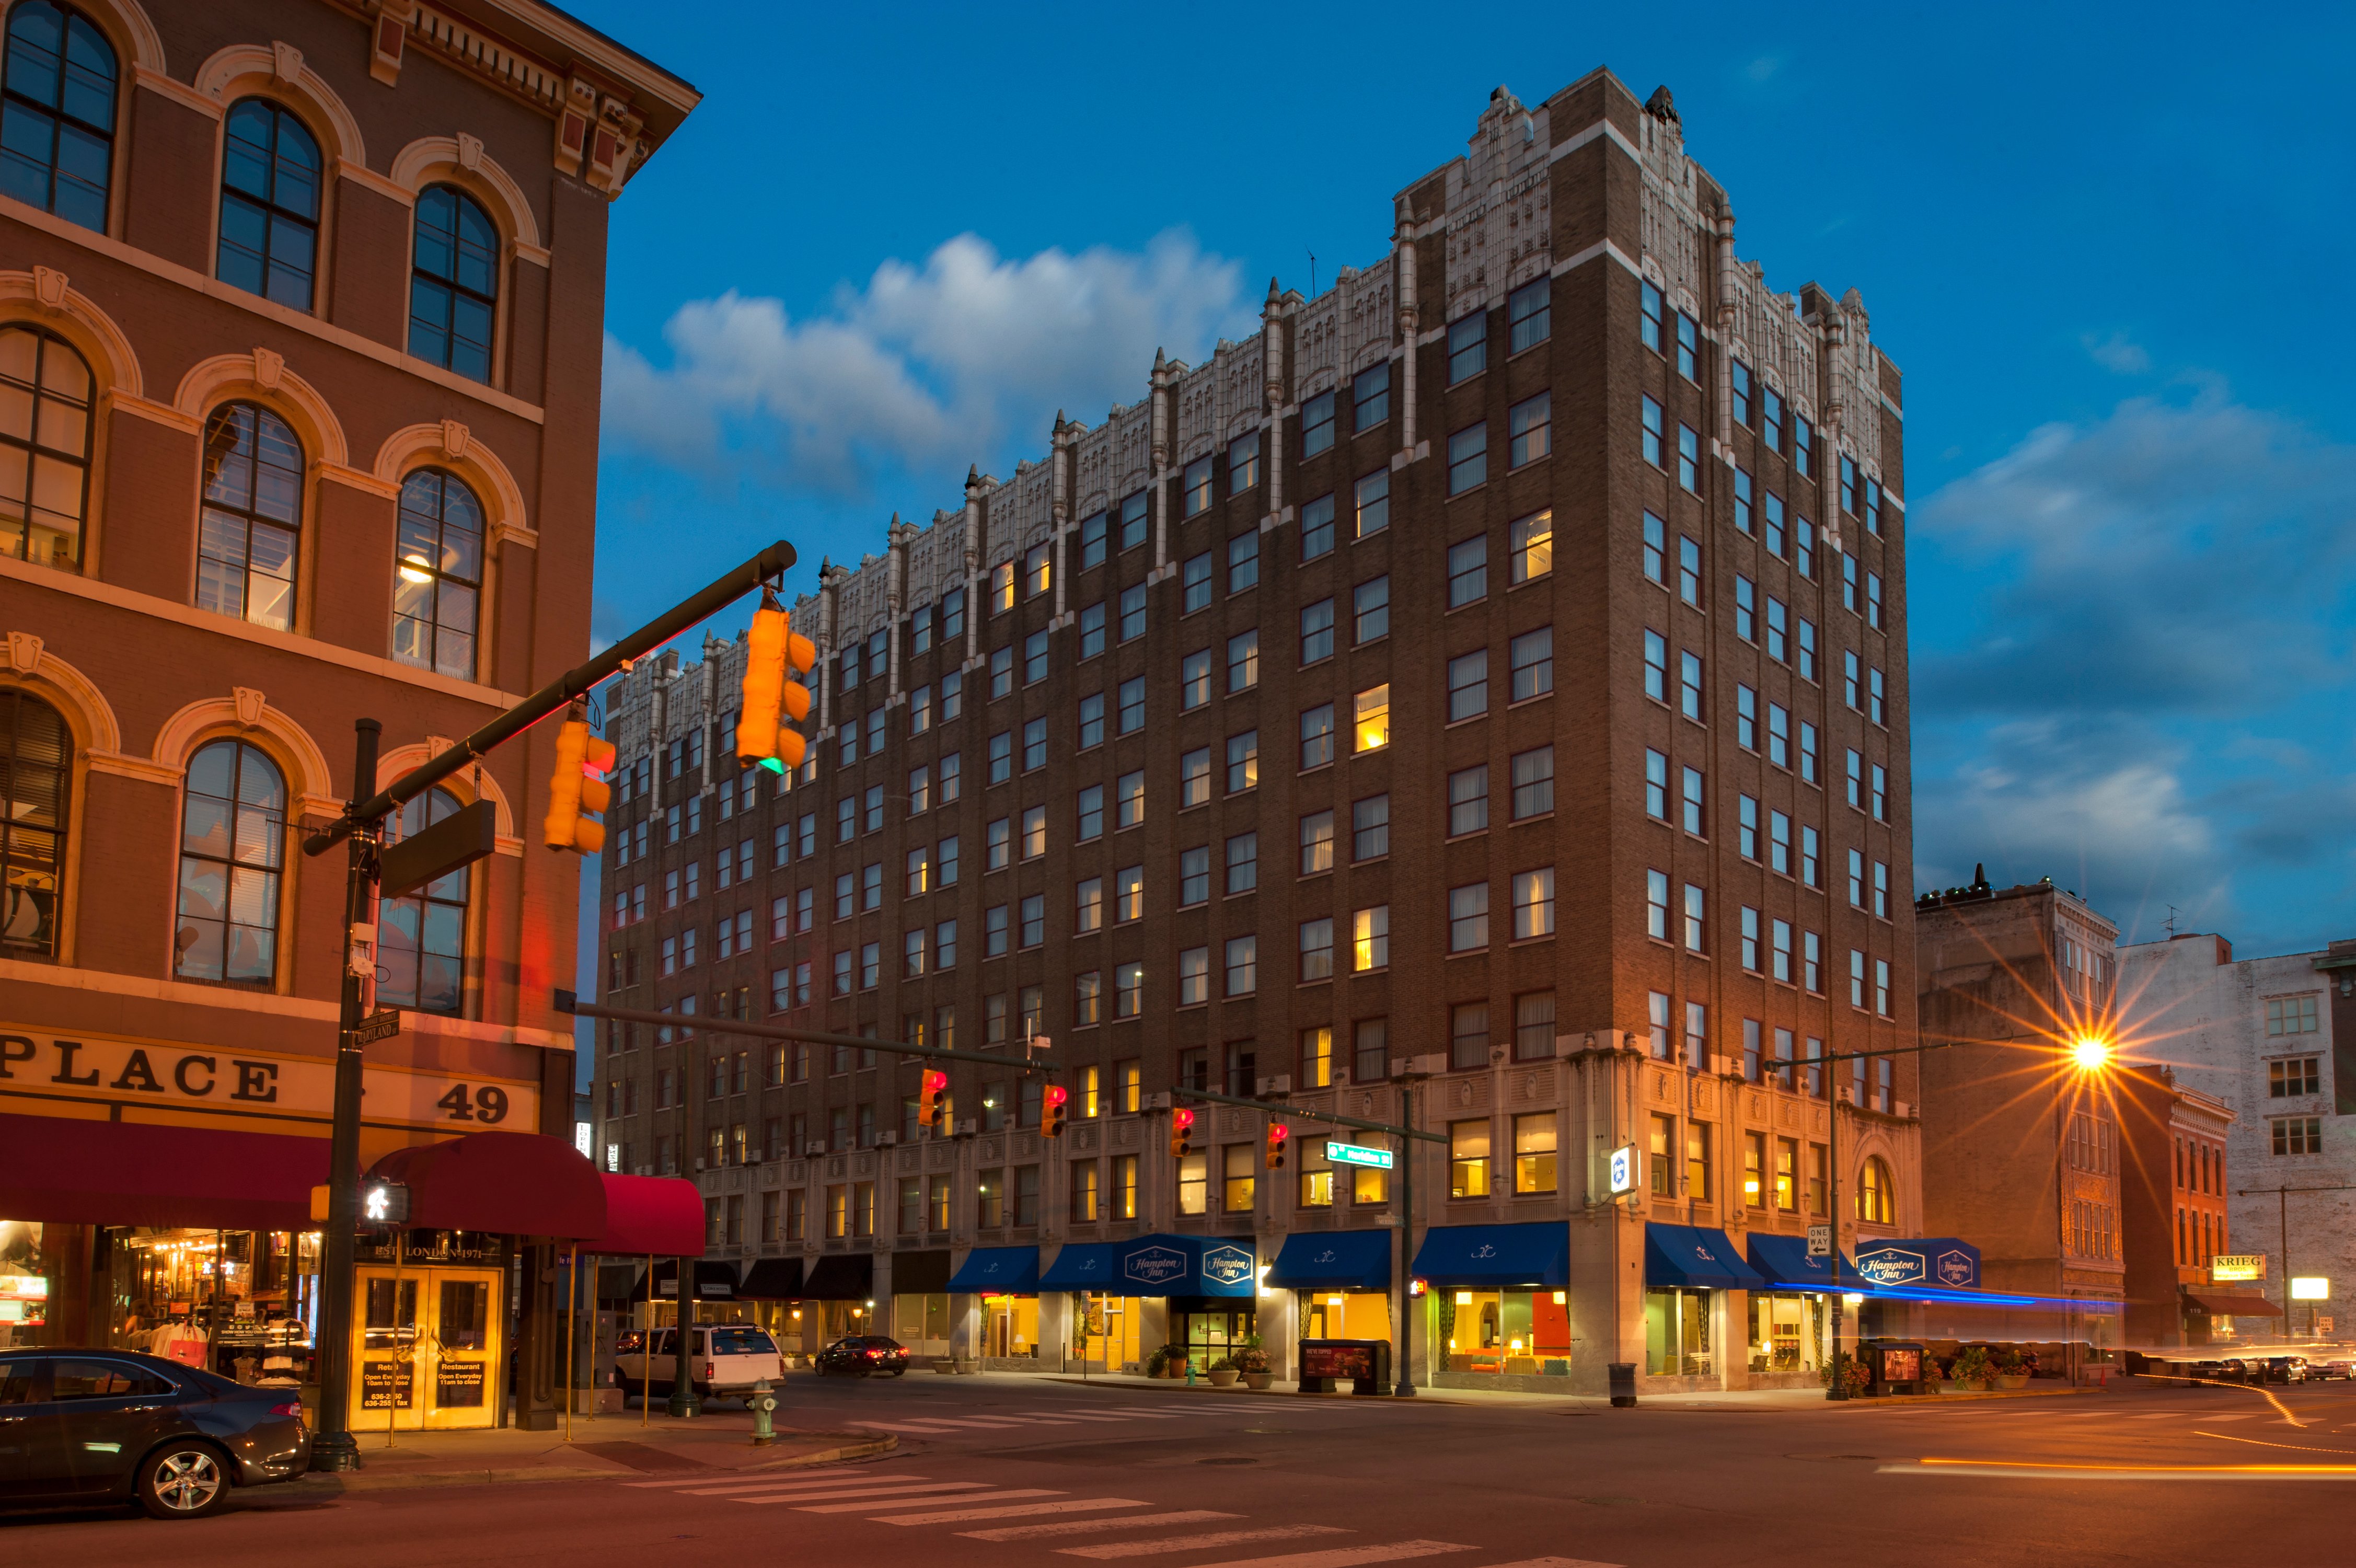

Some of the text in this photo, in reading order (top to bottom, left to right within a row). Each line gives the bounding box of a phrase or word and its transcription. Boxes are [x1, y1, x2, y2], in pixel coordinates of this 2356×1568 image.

[357, 1024, 391, 1043] MARYLAND
[0, 1034, 278, 1102] PLACE
[438, 1083, 509, 1124] 49
[406, 1247, 457, 1258] LONDON
[463, 1249, 482, 1258] 1971
[1130, 1258, 1181, 1271] Hampton
[1208, 1257, 1249, 1270] Hampton
[1861, 1260, 1919, 1273] Hampton
[1941, 1261, 1970, 1274] Hampton
[2216, 1256, 2260, 1266] KRIEG
[1142, 1267, 1168, 1278] Inn
[1218, 1267, 1239, 1278] Inn
[1875, 1270, 1904, 1279] Inn
[1948, 1271, 1962, 1281] Inn
